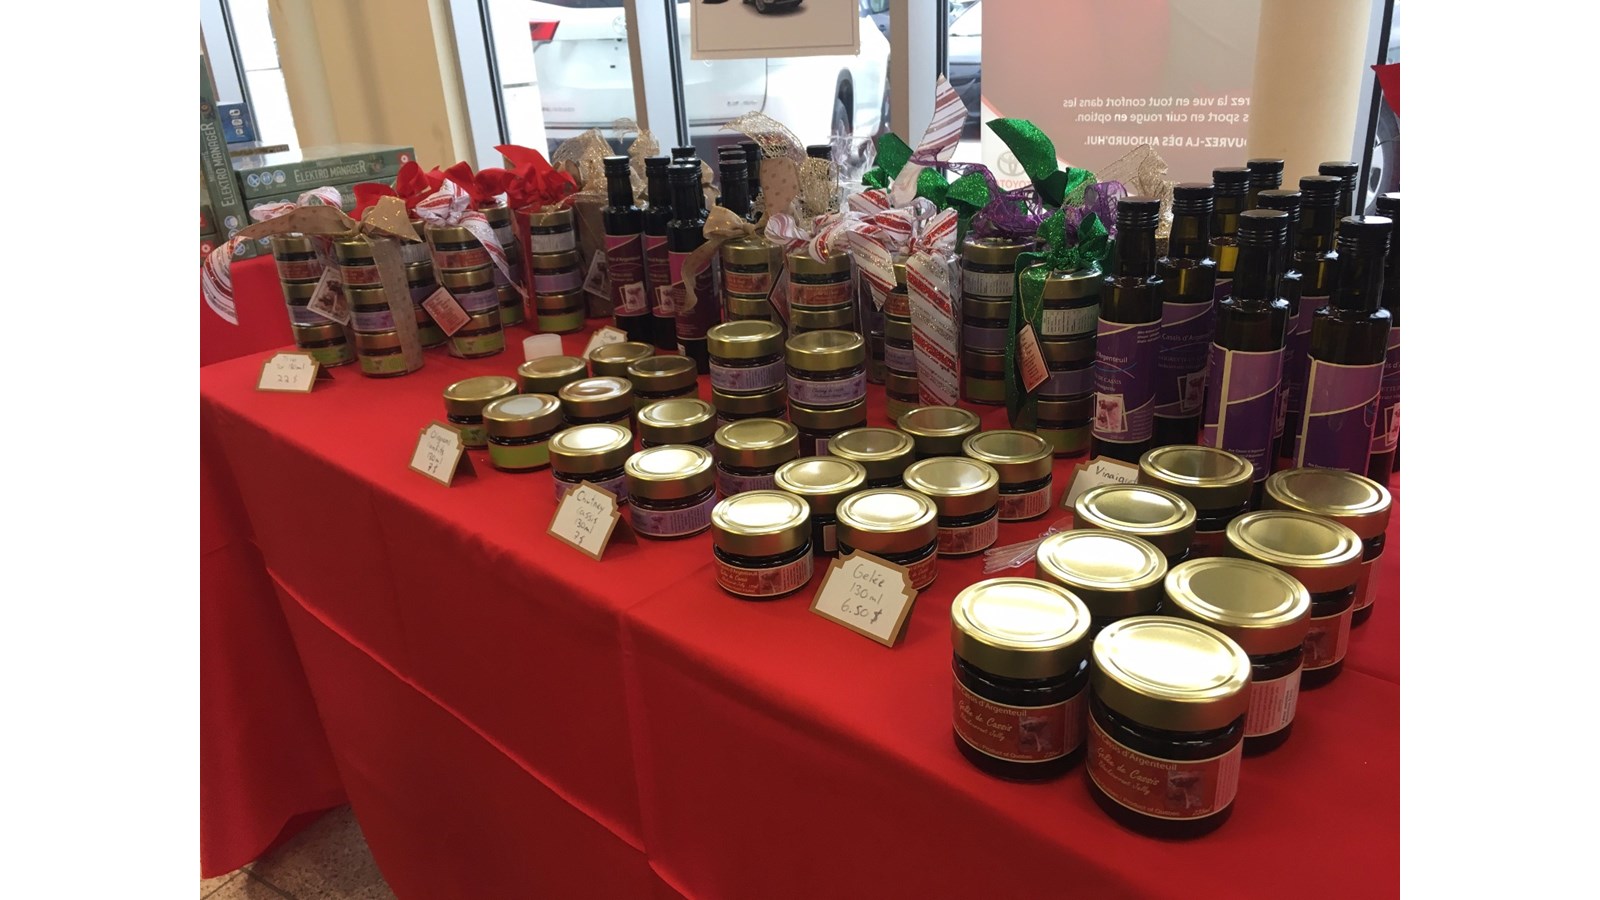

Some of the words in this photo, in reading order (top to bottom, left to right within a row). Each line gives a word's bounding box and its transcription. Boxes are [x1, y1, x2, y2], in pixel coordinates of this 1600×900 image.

[294, 168, 329, 183] ELEKTRO
[330, 160, 367, 177] MANAGER
[852, 564, 885, 587] Gelée
[979, 700, 1026, 716] d'Argenteuil
[986, 718, 1012, 732] Cassis
[1122, 750, 1177, 770] d'Argenteuil
[1130, 770, 1160, 786] Cassis
